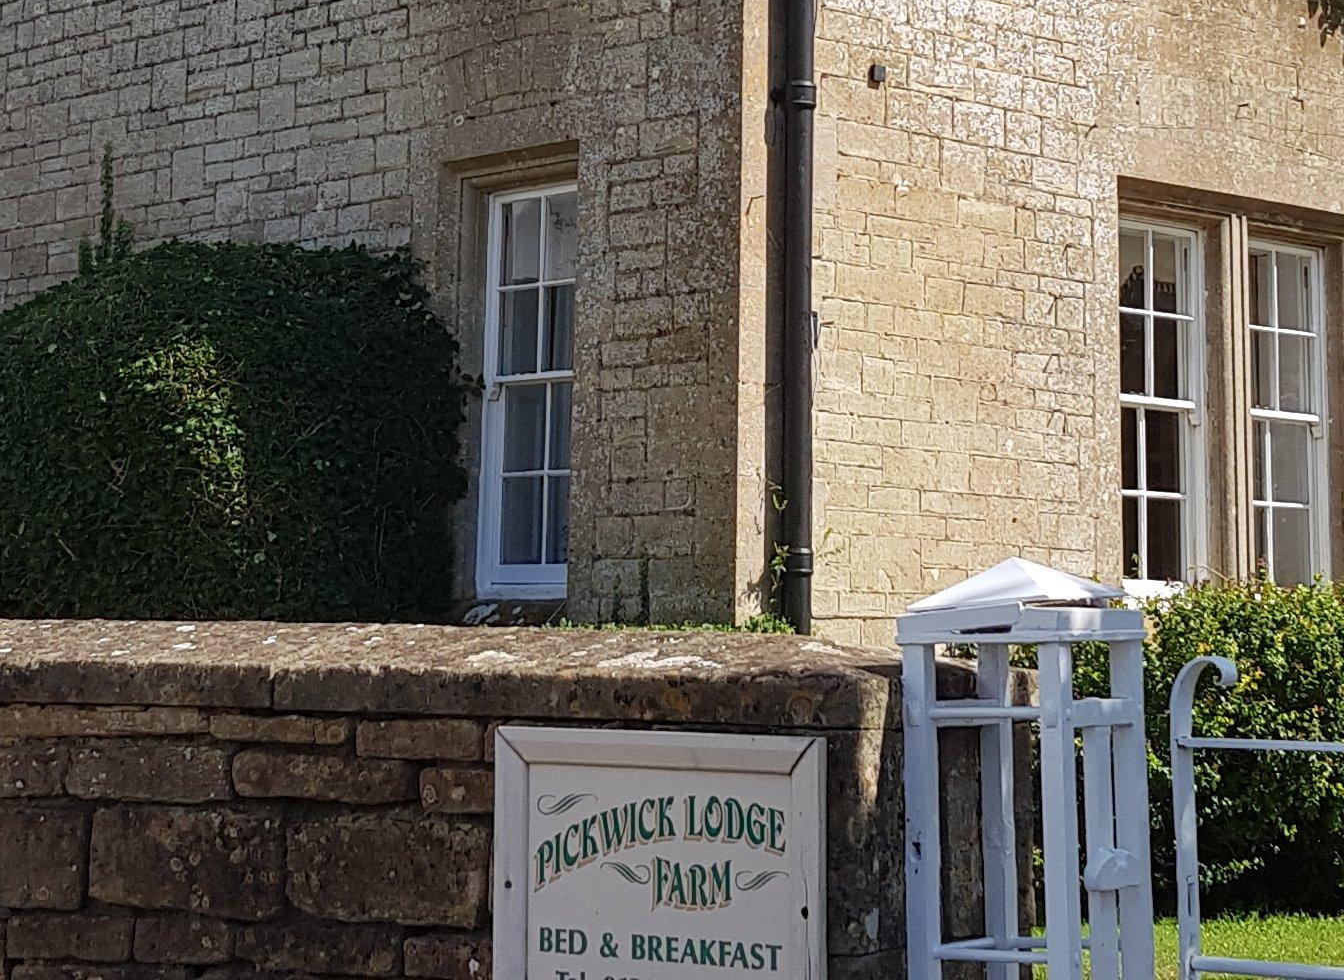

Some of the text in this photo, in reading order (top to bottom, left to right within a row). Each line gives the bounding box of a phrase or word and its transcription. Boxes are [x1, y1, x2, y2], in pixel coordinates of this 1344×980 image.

[536, 795, 787, 889] PICKWICK LODGE
[653, 856, 733, 910] FARM
[539, 927, 782, 971] BED & BREAKFAST
